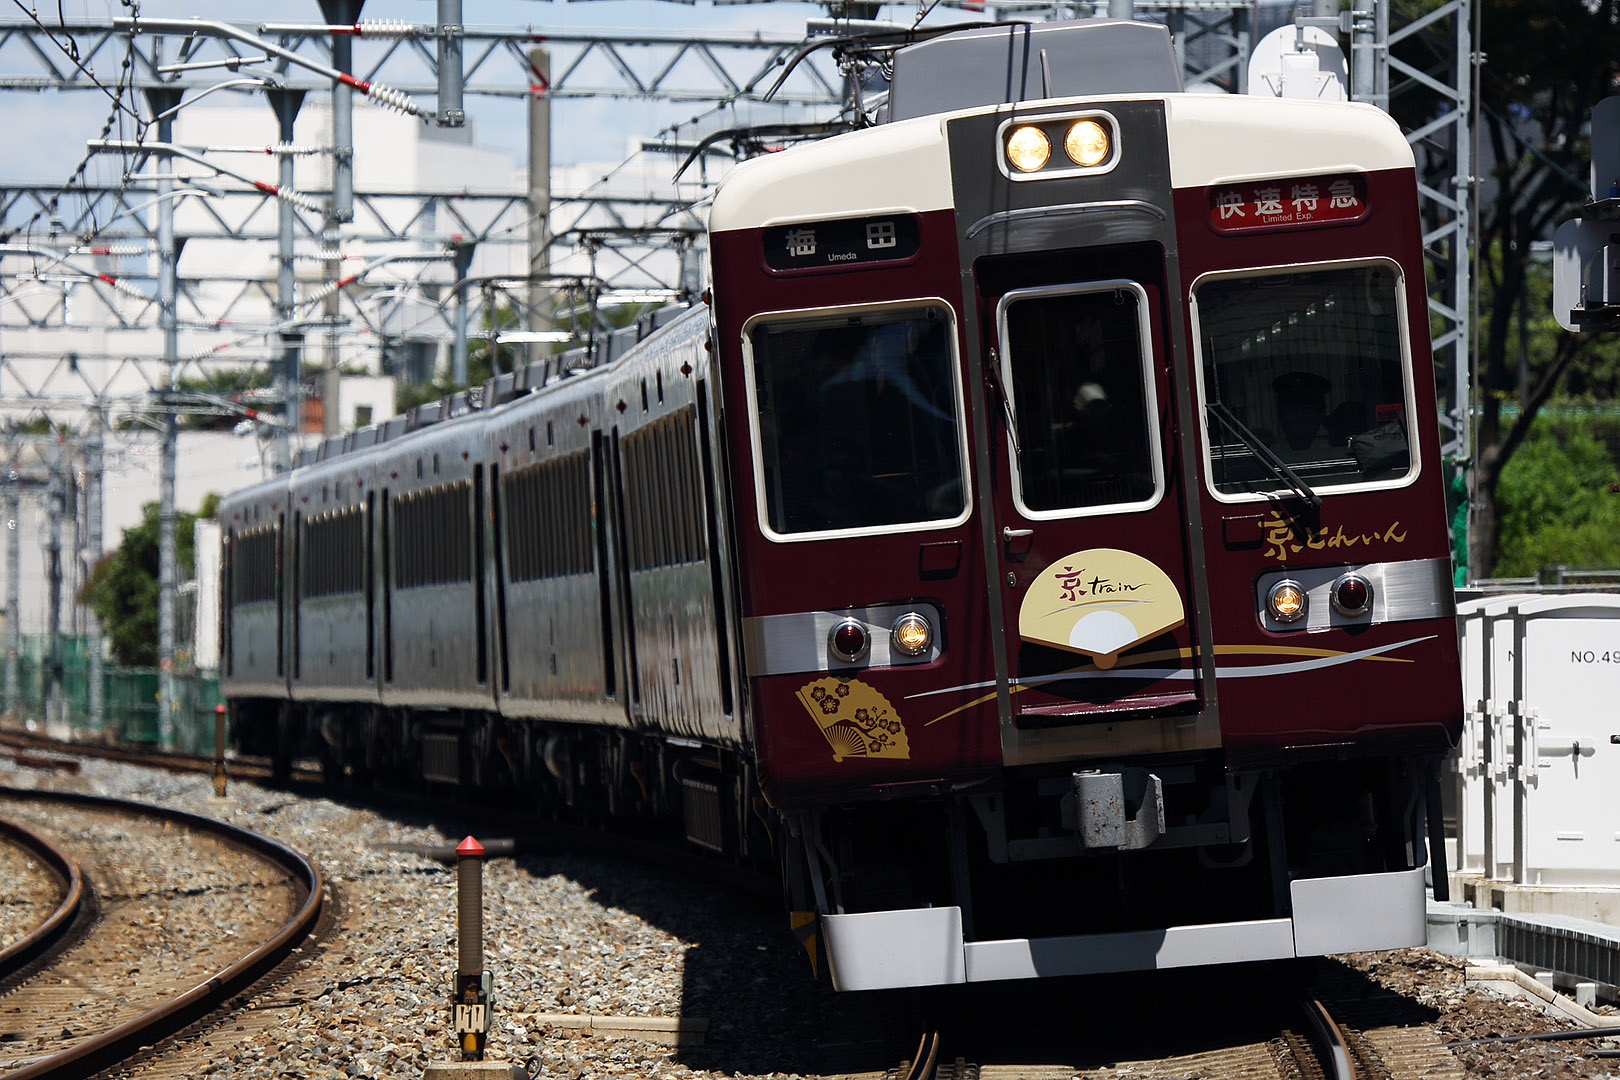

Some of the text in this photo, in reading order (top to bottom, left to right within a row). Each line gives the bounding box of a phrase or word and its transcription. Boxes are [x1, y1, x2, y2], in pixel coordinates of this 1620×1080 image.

[1216, 179, 1358, 220] 快速特急
[1263, 212, 1314, 223] Limited Exp.
[785, 221, 897, 257] 梅田
[828, 251, 857, 262] Umeda
[1257, 510, 1408, 561] 京とれいん
